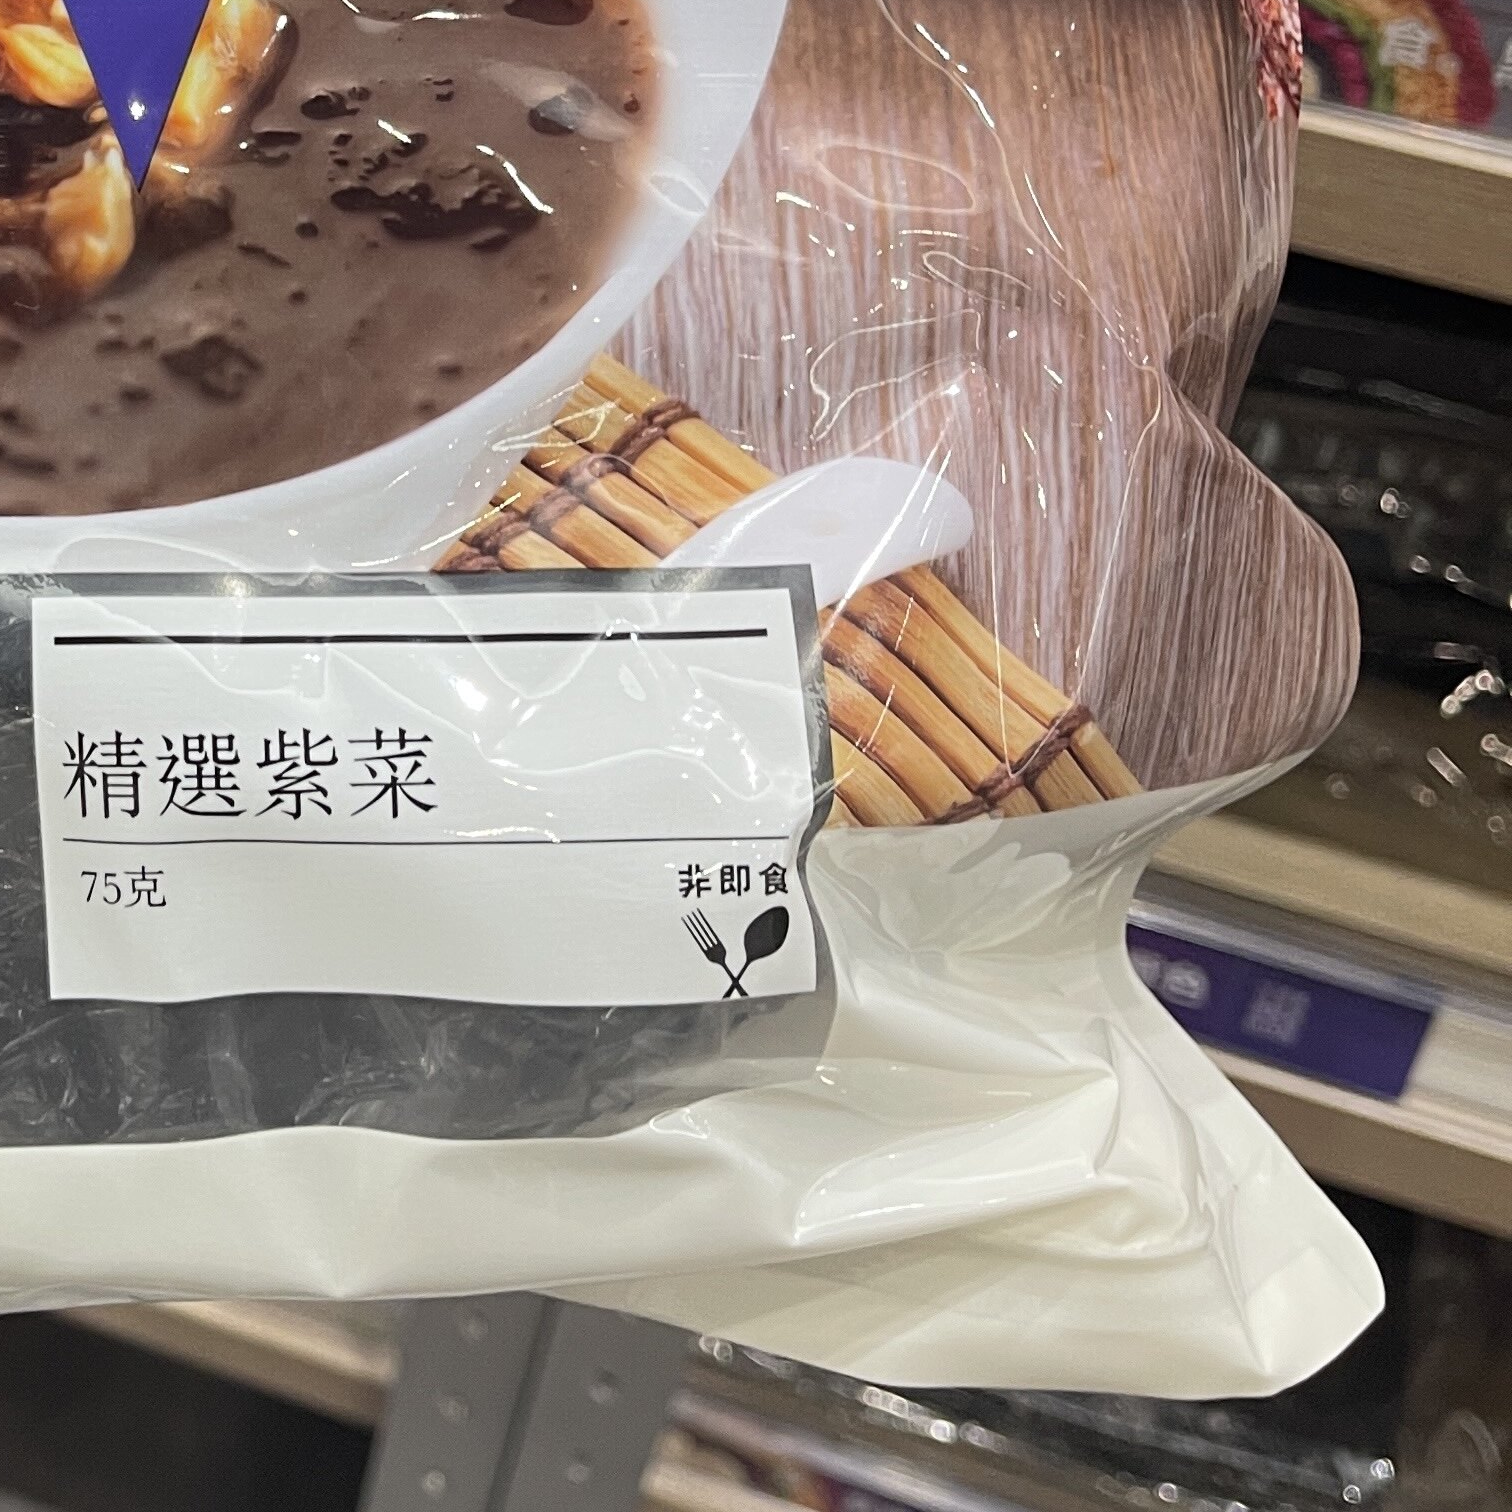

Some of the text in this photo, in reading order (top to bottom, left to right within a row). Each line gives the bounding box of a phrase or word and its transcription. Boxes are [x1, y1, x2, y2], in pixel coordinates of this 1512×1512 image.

[62, 727, 438, 820] 精選紫菜
[80, 865, 168, 909] 75克
[678, 862, 790, 899] 非即食
